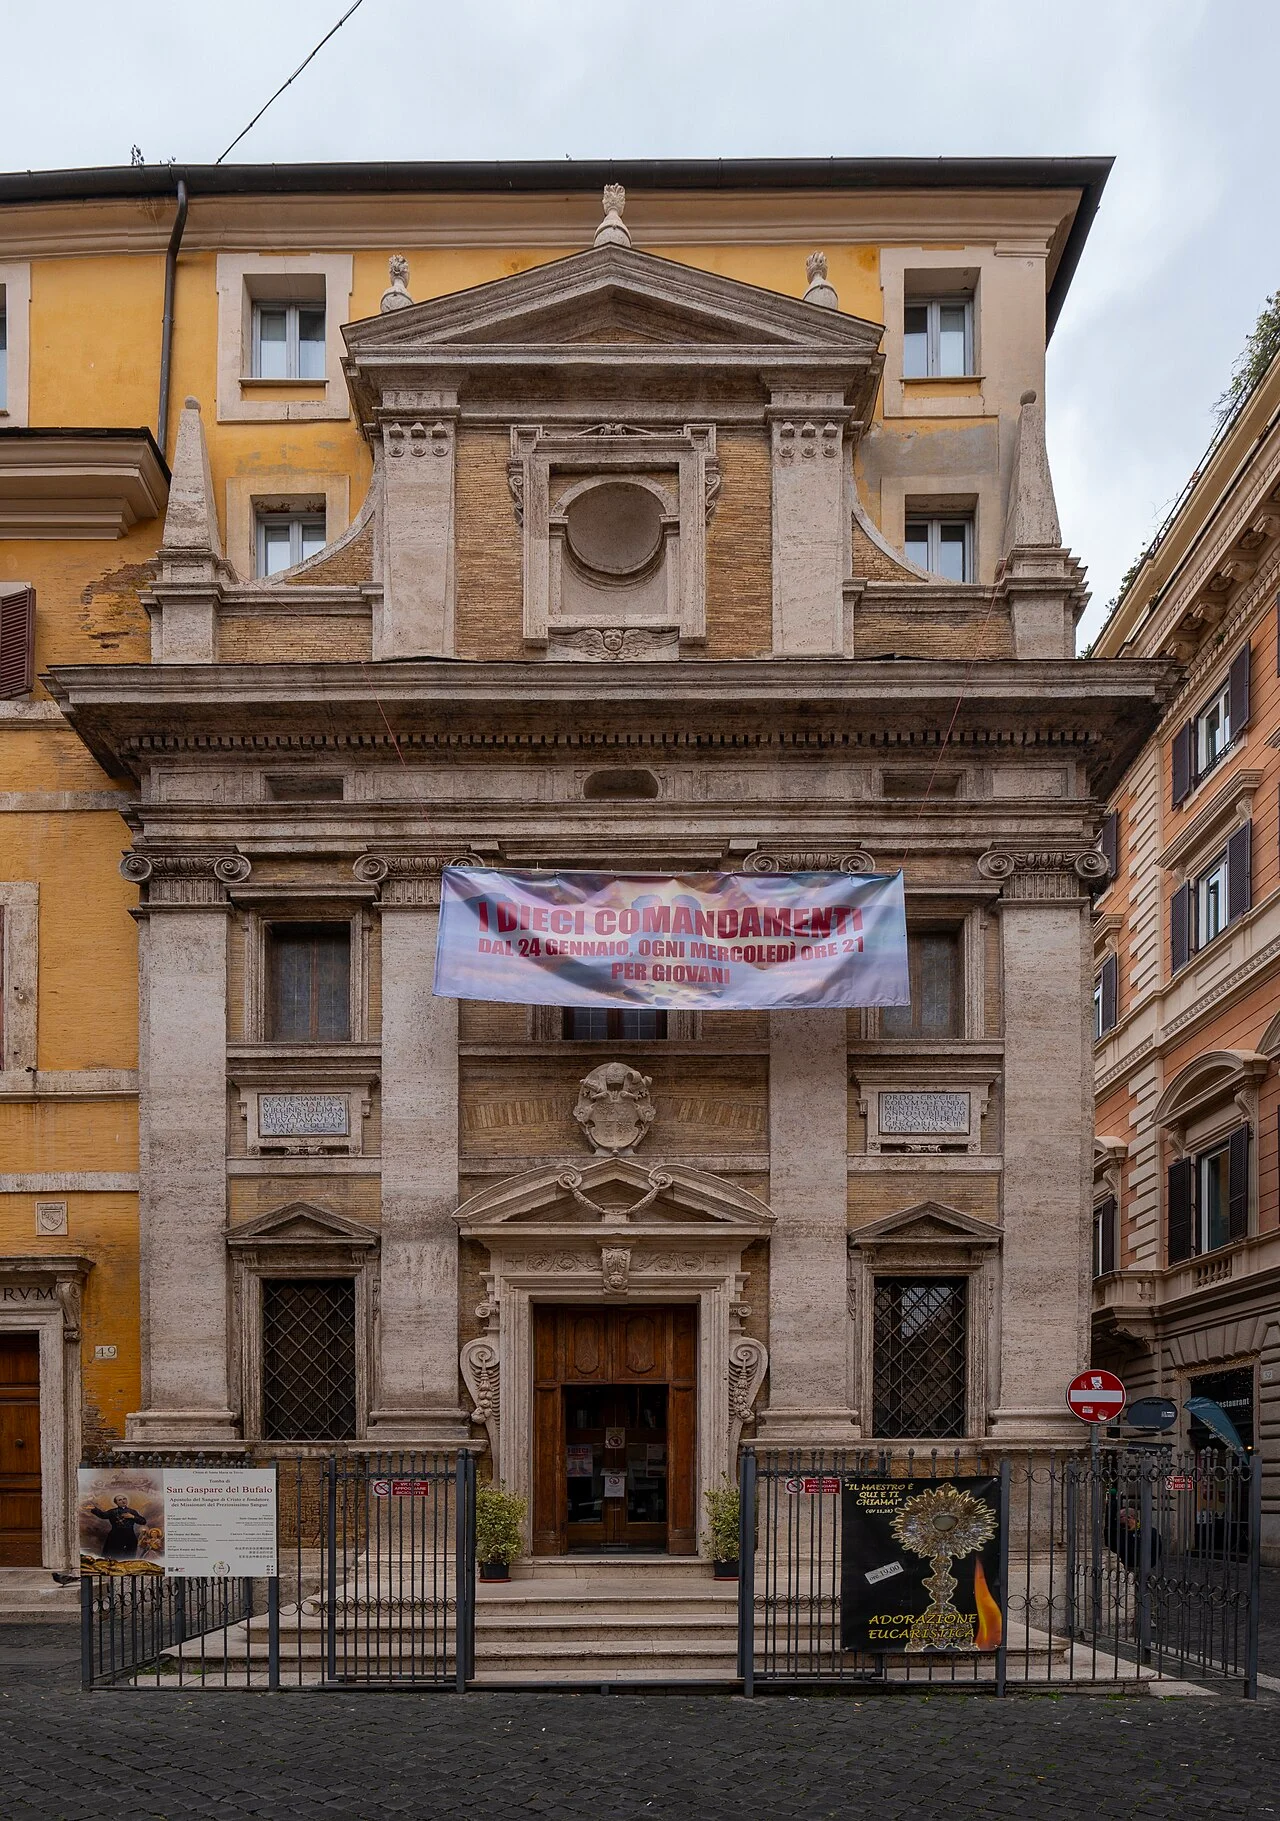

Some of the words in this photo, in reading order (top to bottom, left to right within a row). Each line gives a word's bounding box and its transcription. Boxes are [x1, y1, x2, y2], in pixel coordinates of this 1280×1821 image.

[478, 902, 488, 932] I
[496, 901, 585, 935] DIECI
[594, 906, 864, 939] COMANDAMENTI
[478, 938, 514, 957] DAL
[518, 938, 542, 958] 24
[546, 938, 634, 958] GENNAIO,
[638, 939, 685, 958] OGNI
[690, 941, 796, 964] MERCOLEDÌ
[801, 942, 838, 961] ORE
[842, 936, 864, 952] 21
[611, 962, 646, 980] PER
[652, 964, 730, 984] GIOVANI
[4, 1287, 54, 1301] RVM
[96, 1346, 116, 1358] 49
[186, 1486, 223, 1494] Gaspare
[869, 1613, 978, 1624] ADORAZIONE
[869, 1628, 975, 1639] EUCARISTICA
